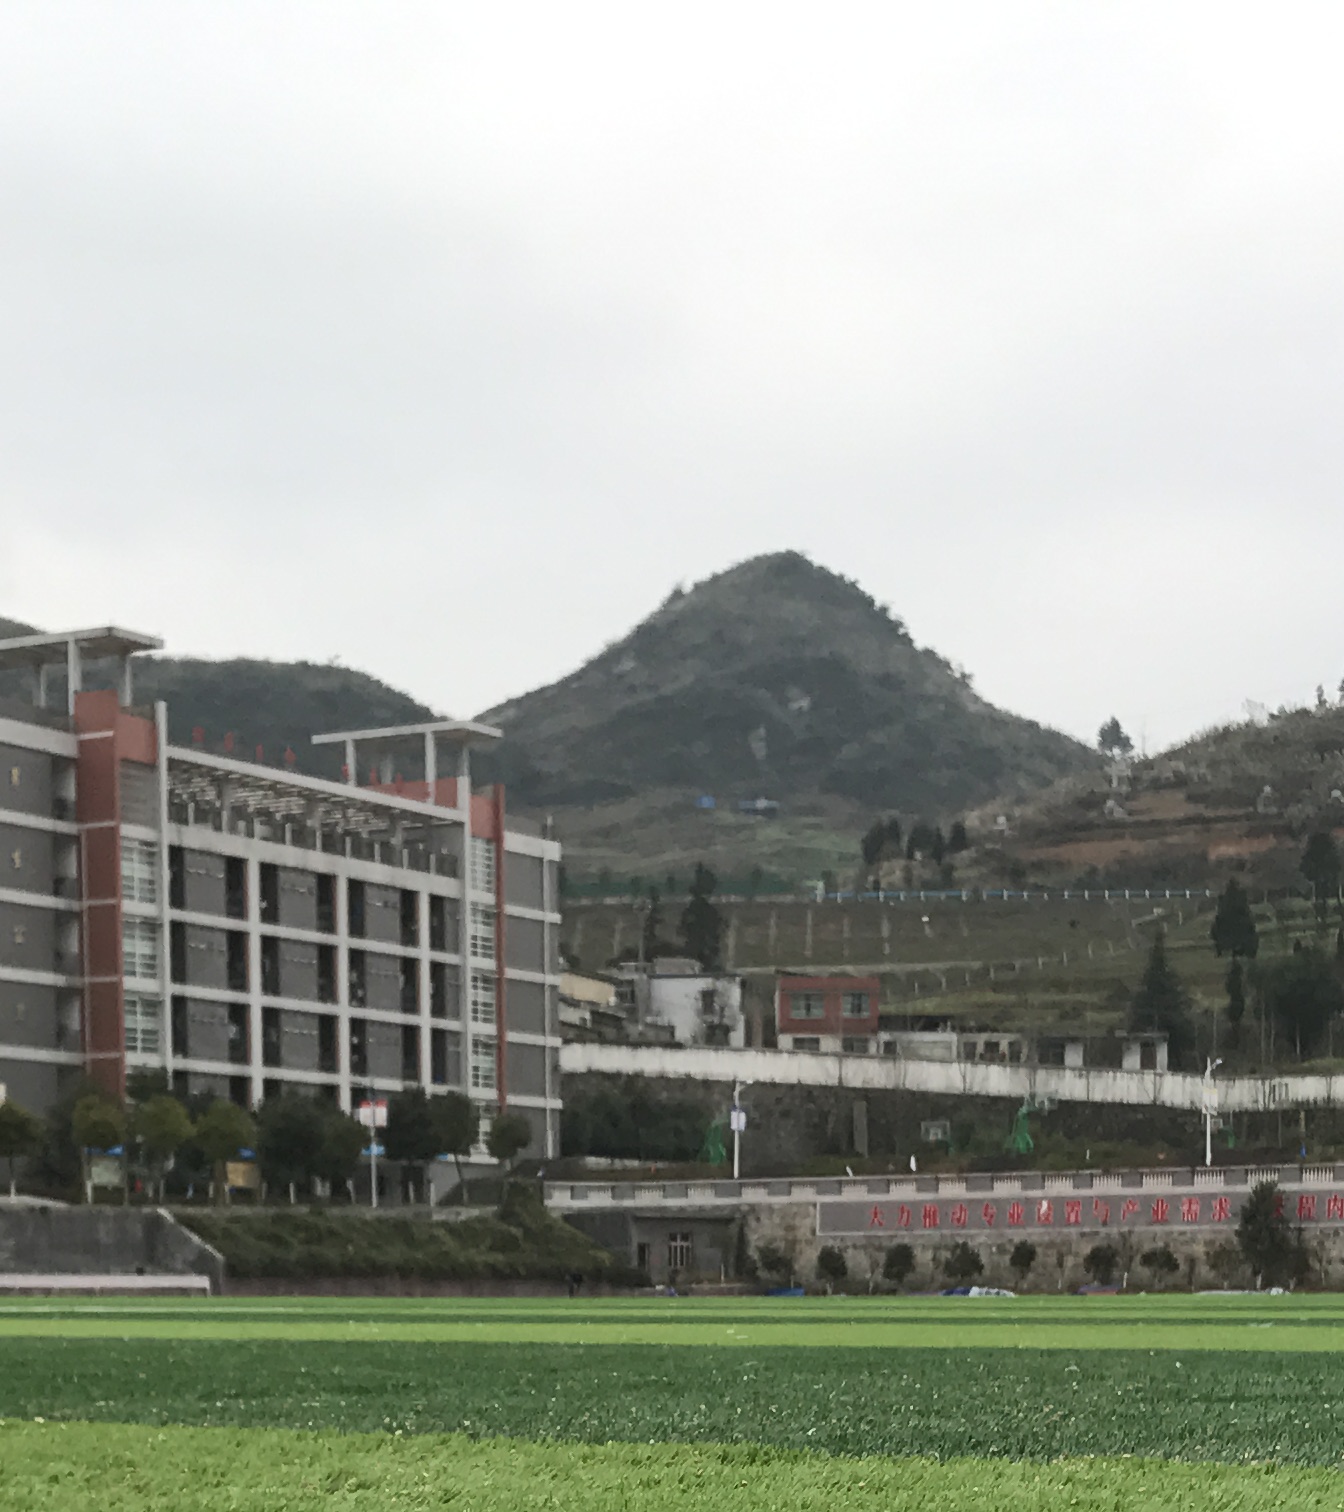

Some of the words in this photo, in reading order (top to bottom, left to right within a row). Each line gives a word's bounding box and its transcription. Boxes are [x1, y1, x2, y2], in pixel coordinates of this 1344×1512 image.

[867, 1196, 1233, 1230] 大力推动专业设置与产业需求
